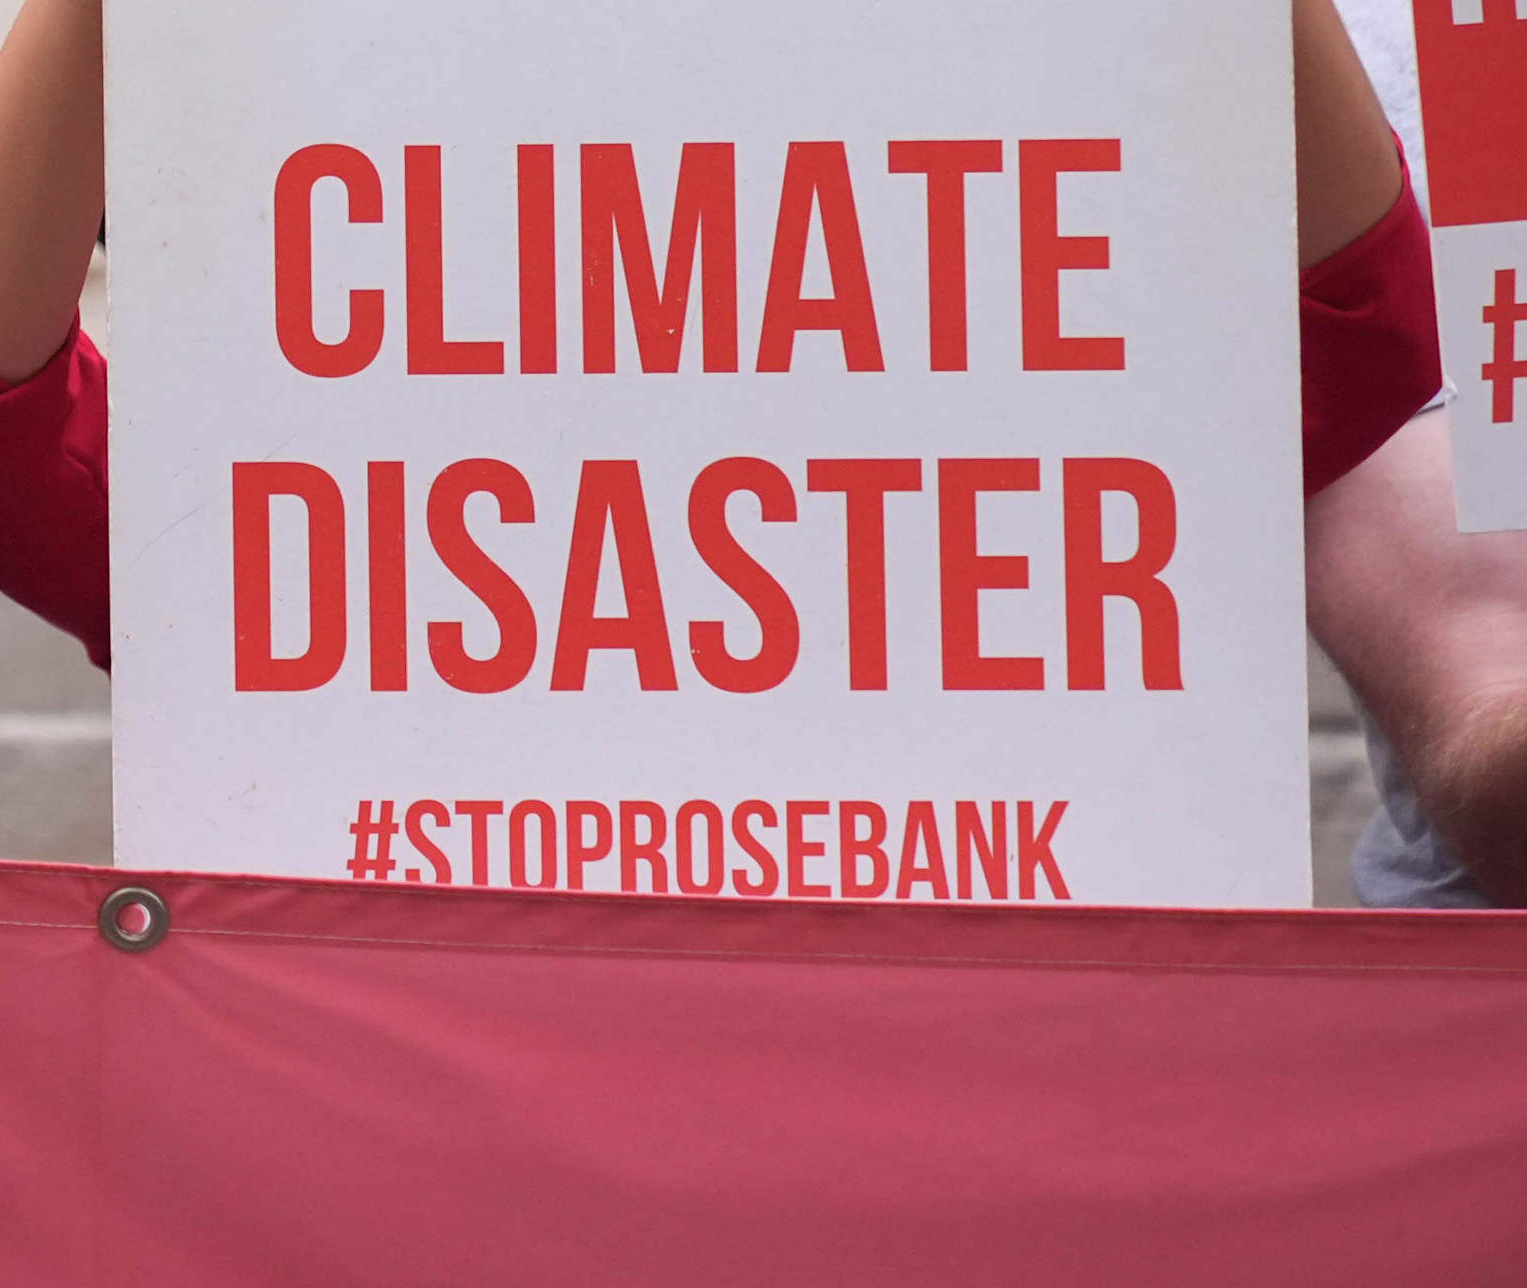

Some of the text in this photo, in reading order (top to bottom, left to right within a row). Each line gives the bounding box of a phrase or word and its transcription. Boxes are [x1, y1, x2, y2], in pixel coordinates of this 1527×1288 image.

[274, 138, 1126, 379] CLIMATE
[232, 456, 1185, 694] DISASTER
[346, 799, 1072, 900] #STOPROSEBANK
